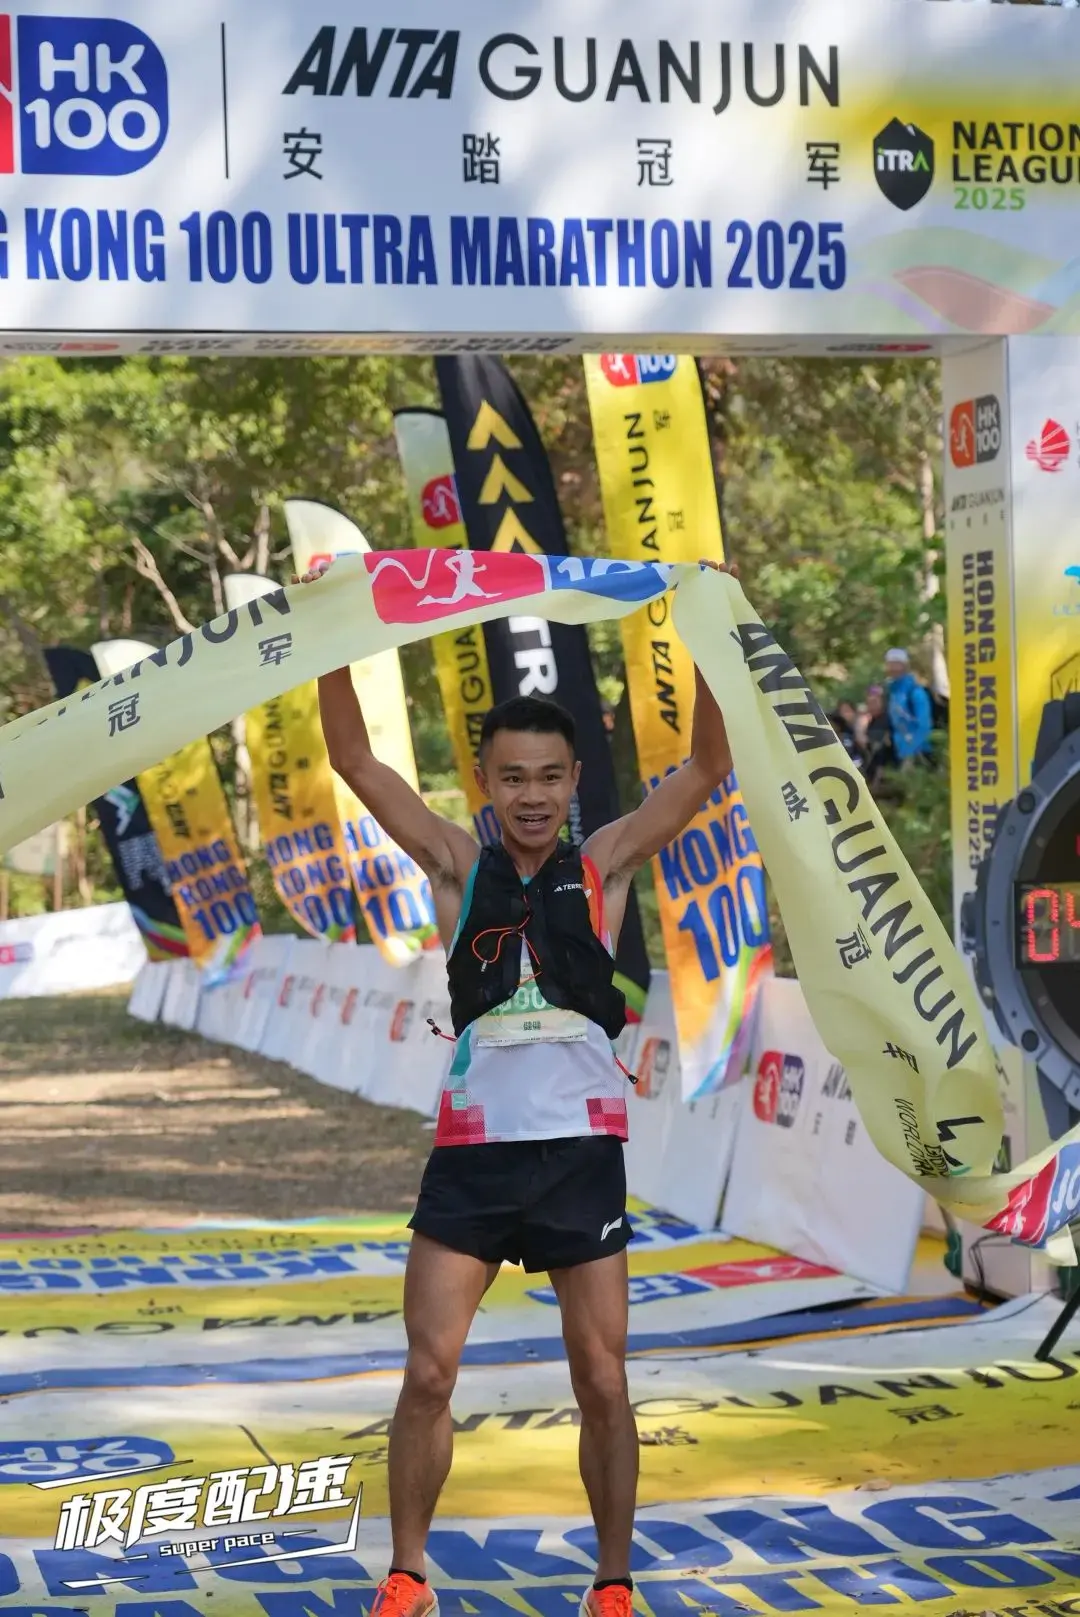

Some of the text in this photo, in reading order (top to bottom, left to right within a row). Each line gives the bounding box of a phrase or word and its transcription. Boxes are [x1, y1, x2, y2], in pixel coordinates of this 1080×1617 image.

[39, 41, 147, 94] HK
[282, 26, 840, 115] ANTA GUANJUN
[24, 97, 161, 151] 100
[952, 153, 1080, 185] LEAGU
[953, 186, 1026, 211] 2025
[24, 207, 166, 282] KONG
[180, 210, 272, 284] 100
[288, 212, 438, 286] ULTRA
[450, 215, 712, 289] MARATHON
[726, 220, 847, 291] 2025
[976, 429, 1000, 453] 100
[962, 552, 976, 634] ULTRA
[976, 550, 997, 664] HONG
[108, 632, 293, 737] 冠 军
[655, 640, 682, 735] ANTA
[964, 643, 980, 792] MARATHON
[978, 676, 999, 788] KONG
[168, 839, 230, 881] HONG
[178, 866, 247, 908] KONG
[657, 804, 758, 900] KONG
[730, 623, 977, 1070] ANTA GUANJUN
[193, 891, 259, 941] 100
[678, 864, 770, 983] 100
